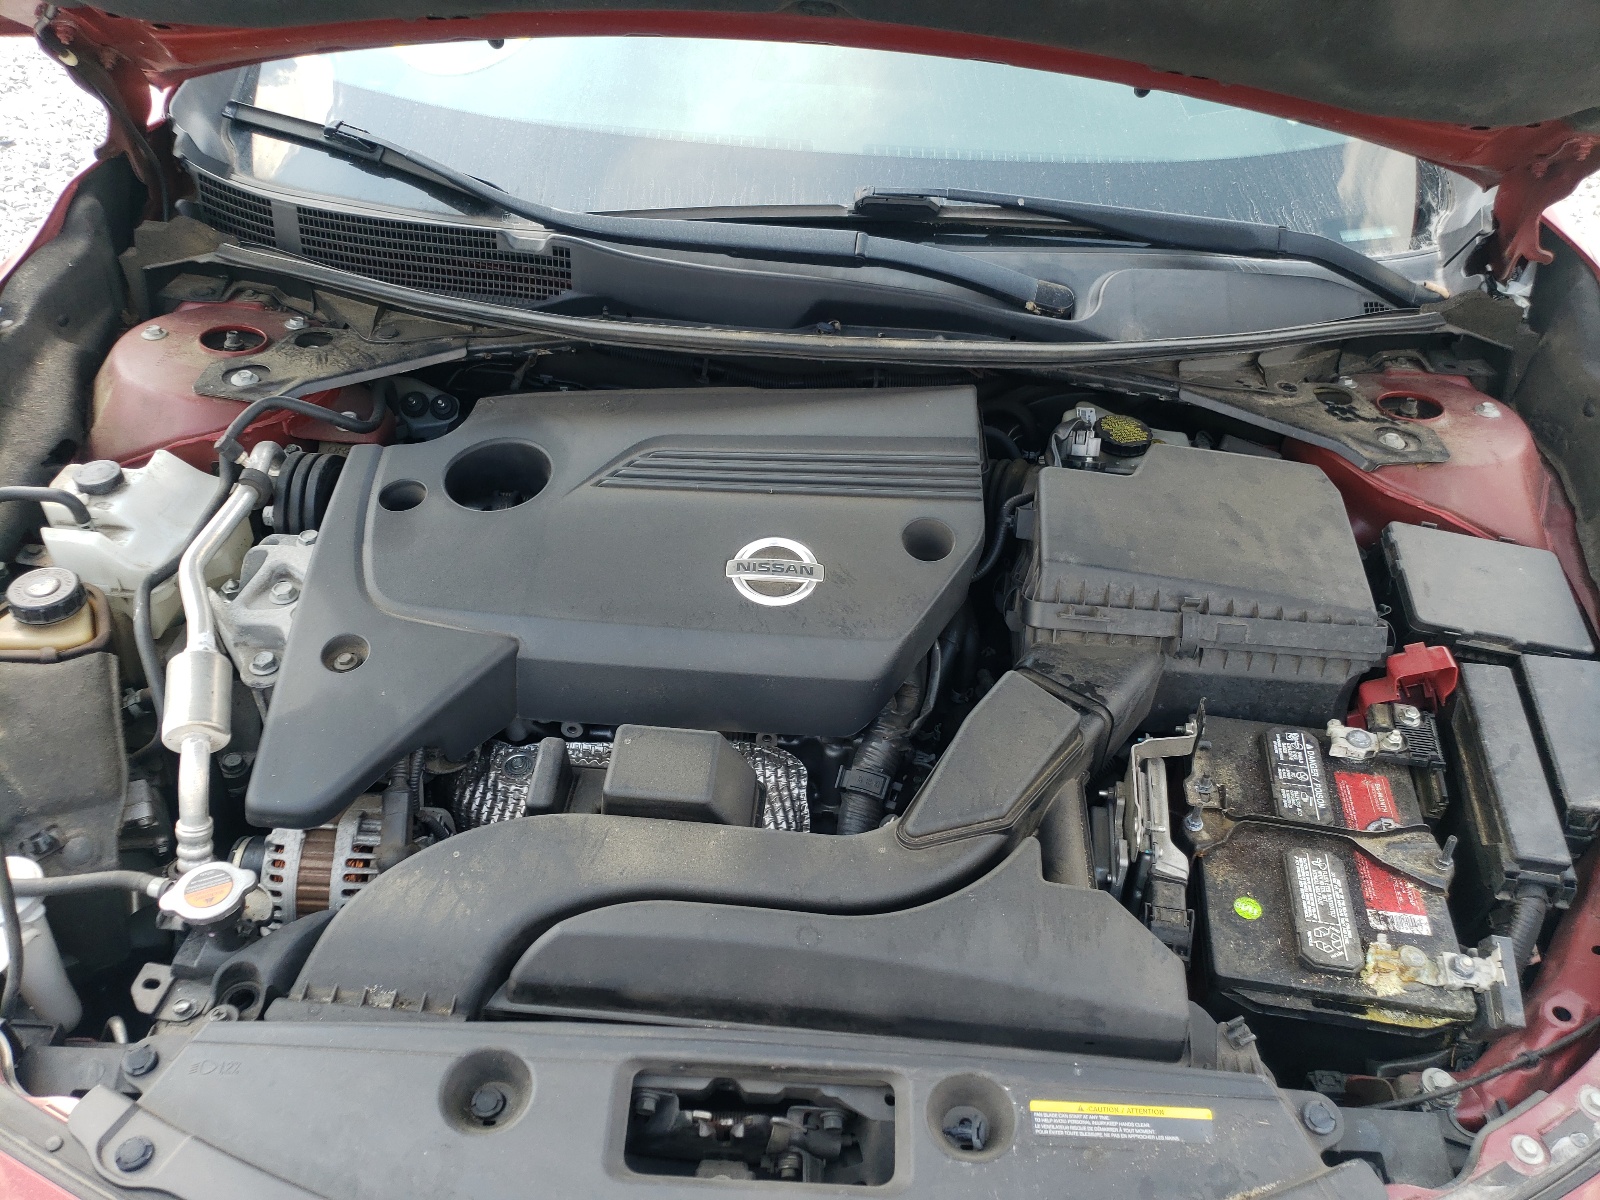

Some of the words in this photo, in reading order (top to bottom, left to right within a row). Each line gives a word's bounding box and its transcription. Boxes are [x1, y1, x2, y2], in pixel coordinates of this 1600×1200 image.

[736, 562, 813, 576] NISSAN
[1307, 750, 1319, 780] DANGER
[1313, 784, 1325, 809] POISON
[1088, 1105, 1118, 1113] CAUTION
[1126, 1107, 1164, 1115] ATTENTION
